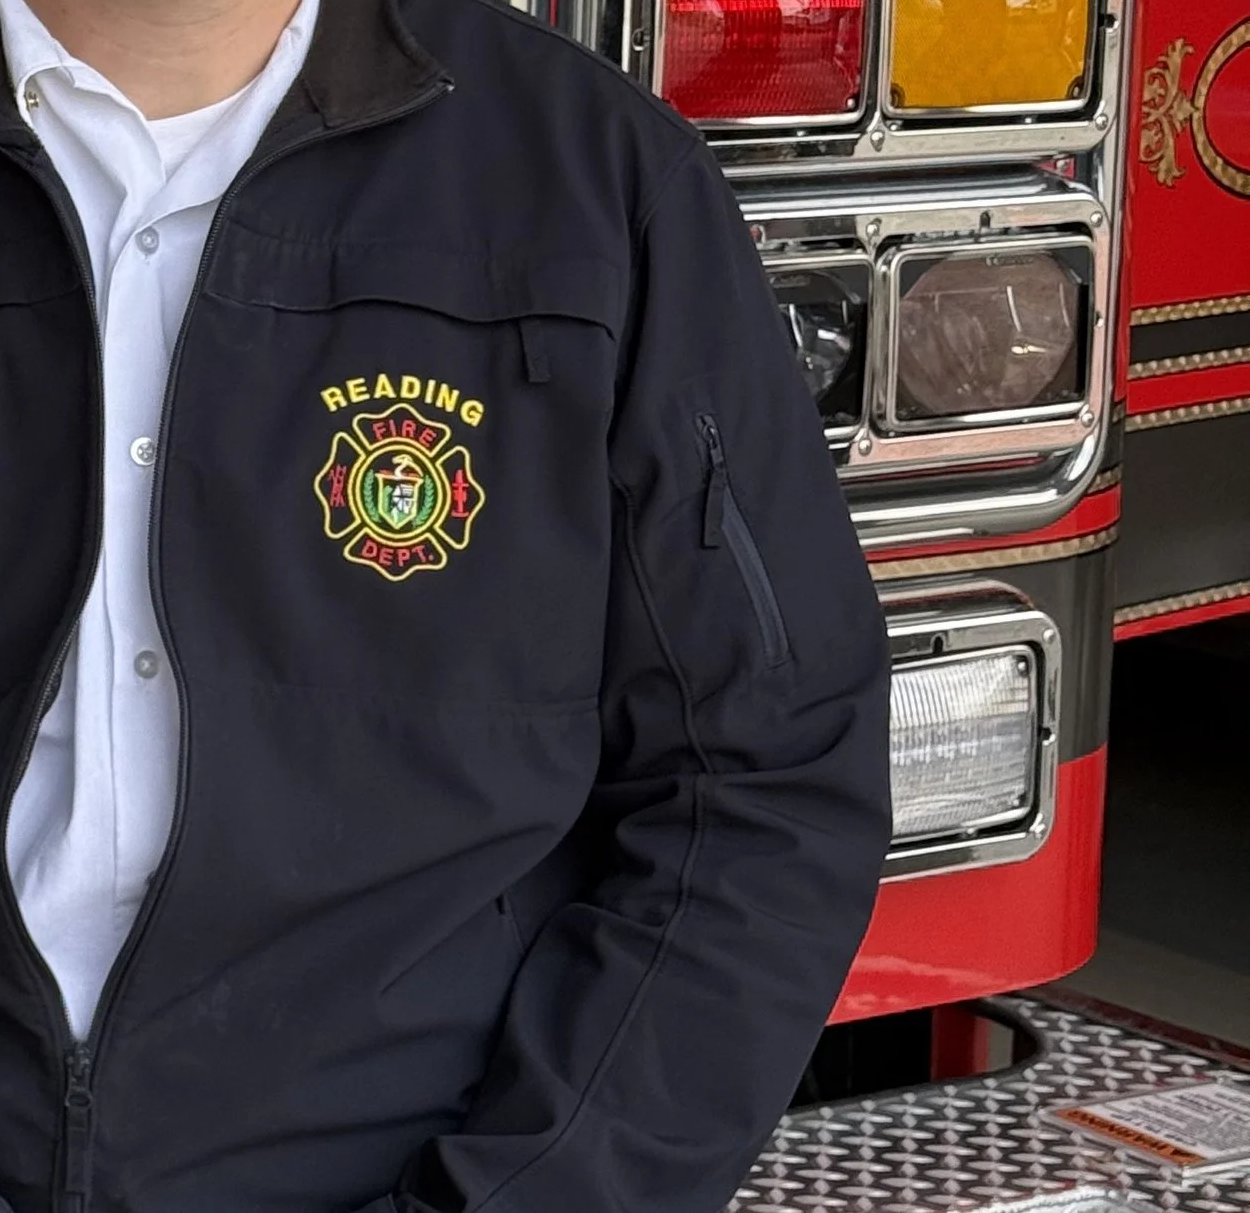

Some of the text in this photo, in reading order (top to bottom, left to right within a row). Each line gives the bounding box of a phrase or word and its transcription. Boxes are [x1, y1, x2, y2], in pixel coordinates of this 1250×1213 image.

[320, 373, 485, 428] READING
[372, 418, 437, 448] FIRE
[361, 538, 435, 568] DEPT.
